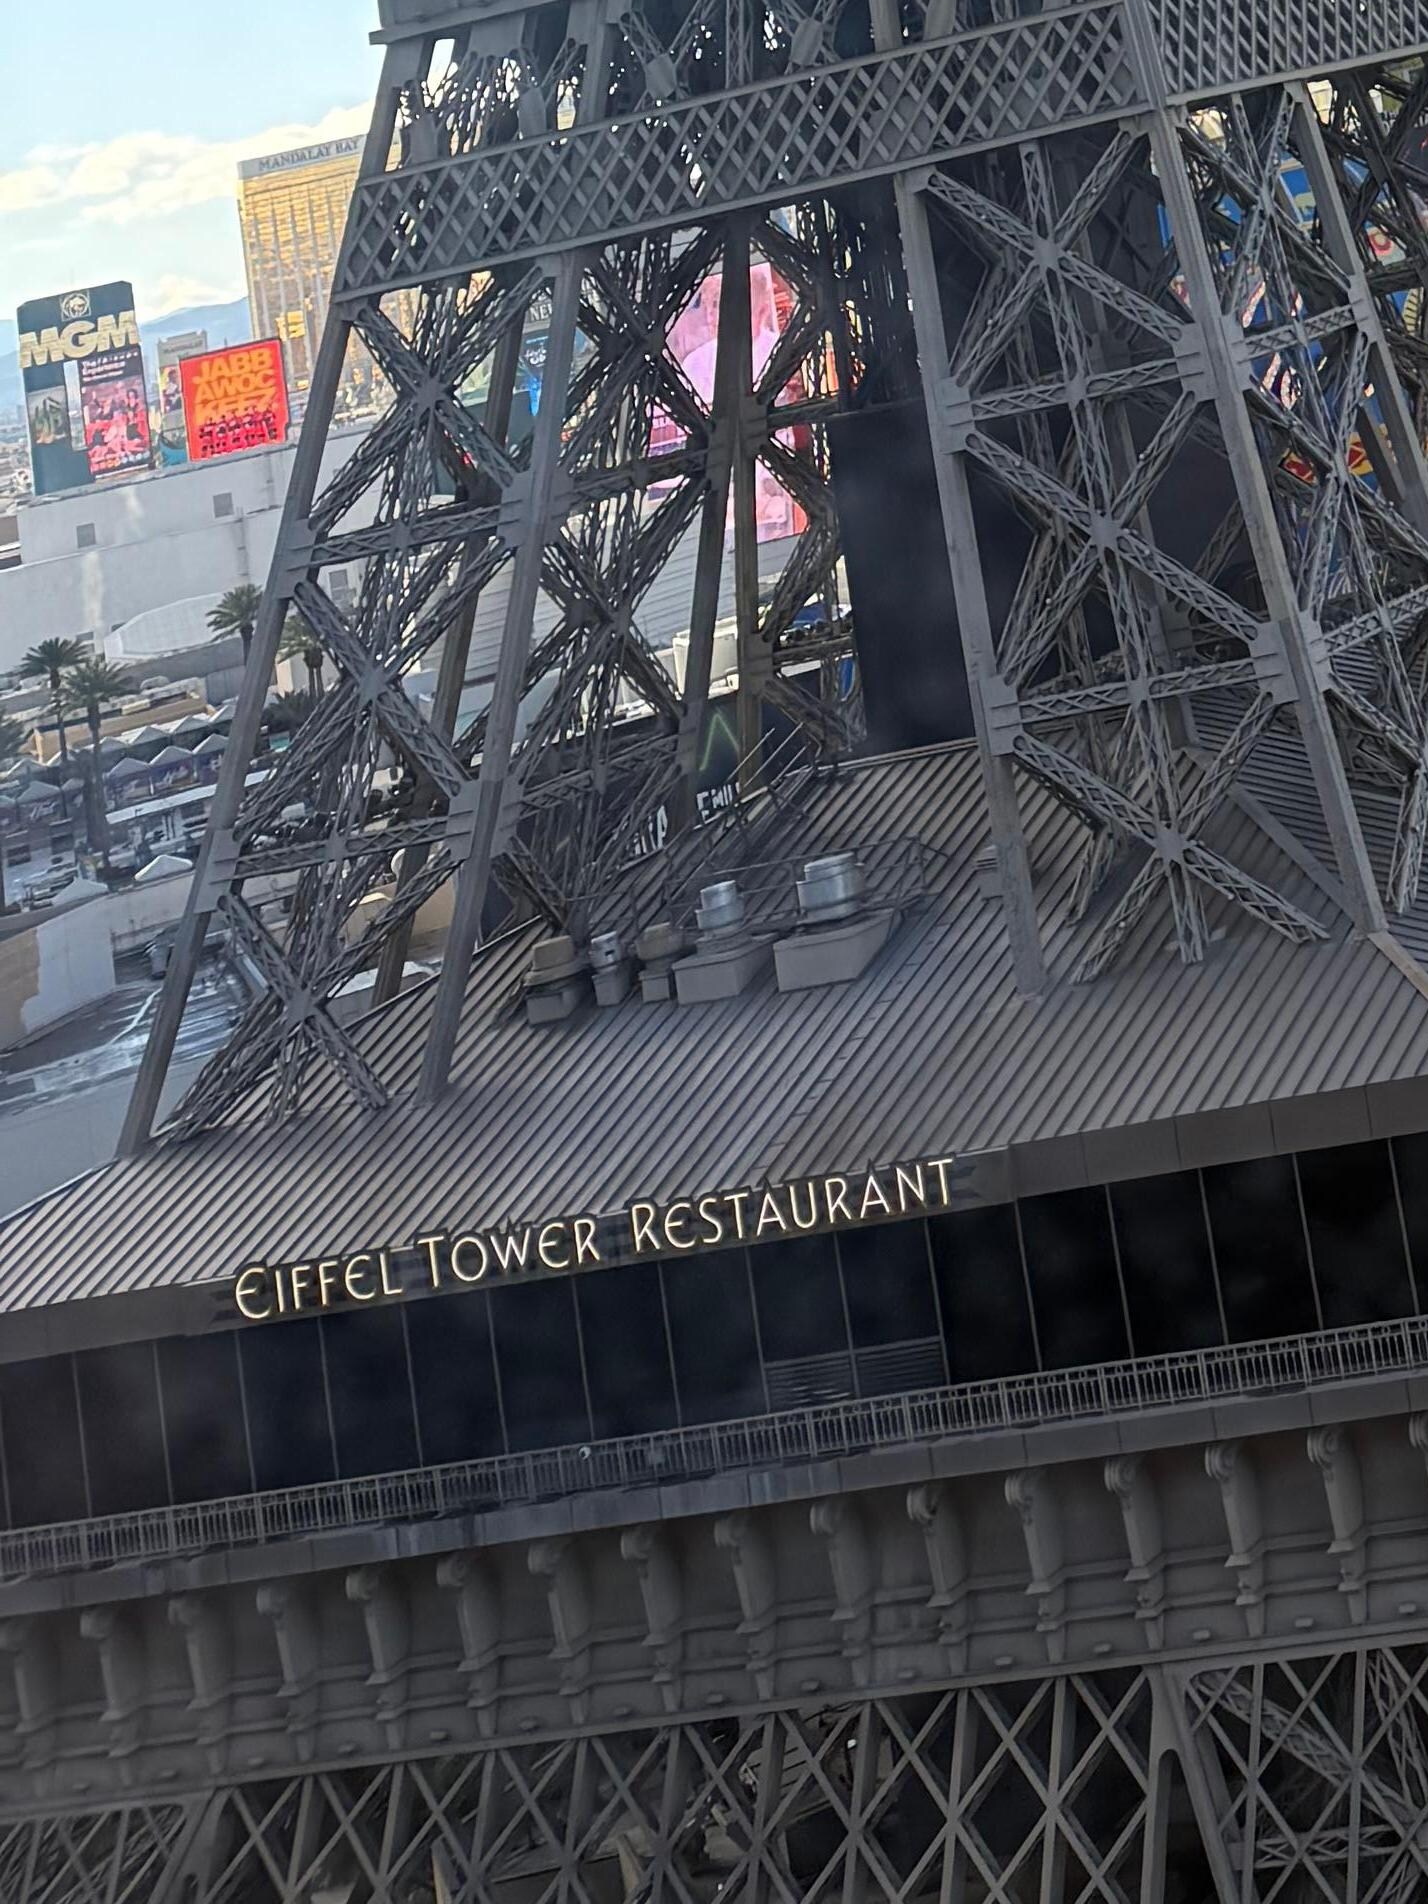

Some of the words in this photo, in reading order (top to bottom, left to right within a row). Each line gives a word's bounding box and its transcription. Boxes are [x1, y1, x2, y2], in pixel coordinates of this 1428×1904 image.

[18, 310, 139, 368] MGM
[234, 1249, 404, 1320] EIFFEL
[417, 1216, 600, 1290] TOWER
[632, 1158, 956, 1253] RESTAURANT
